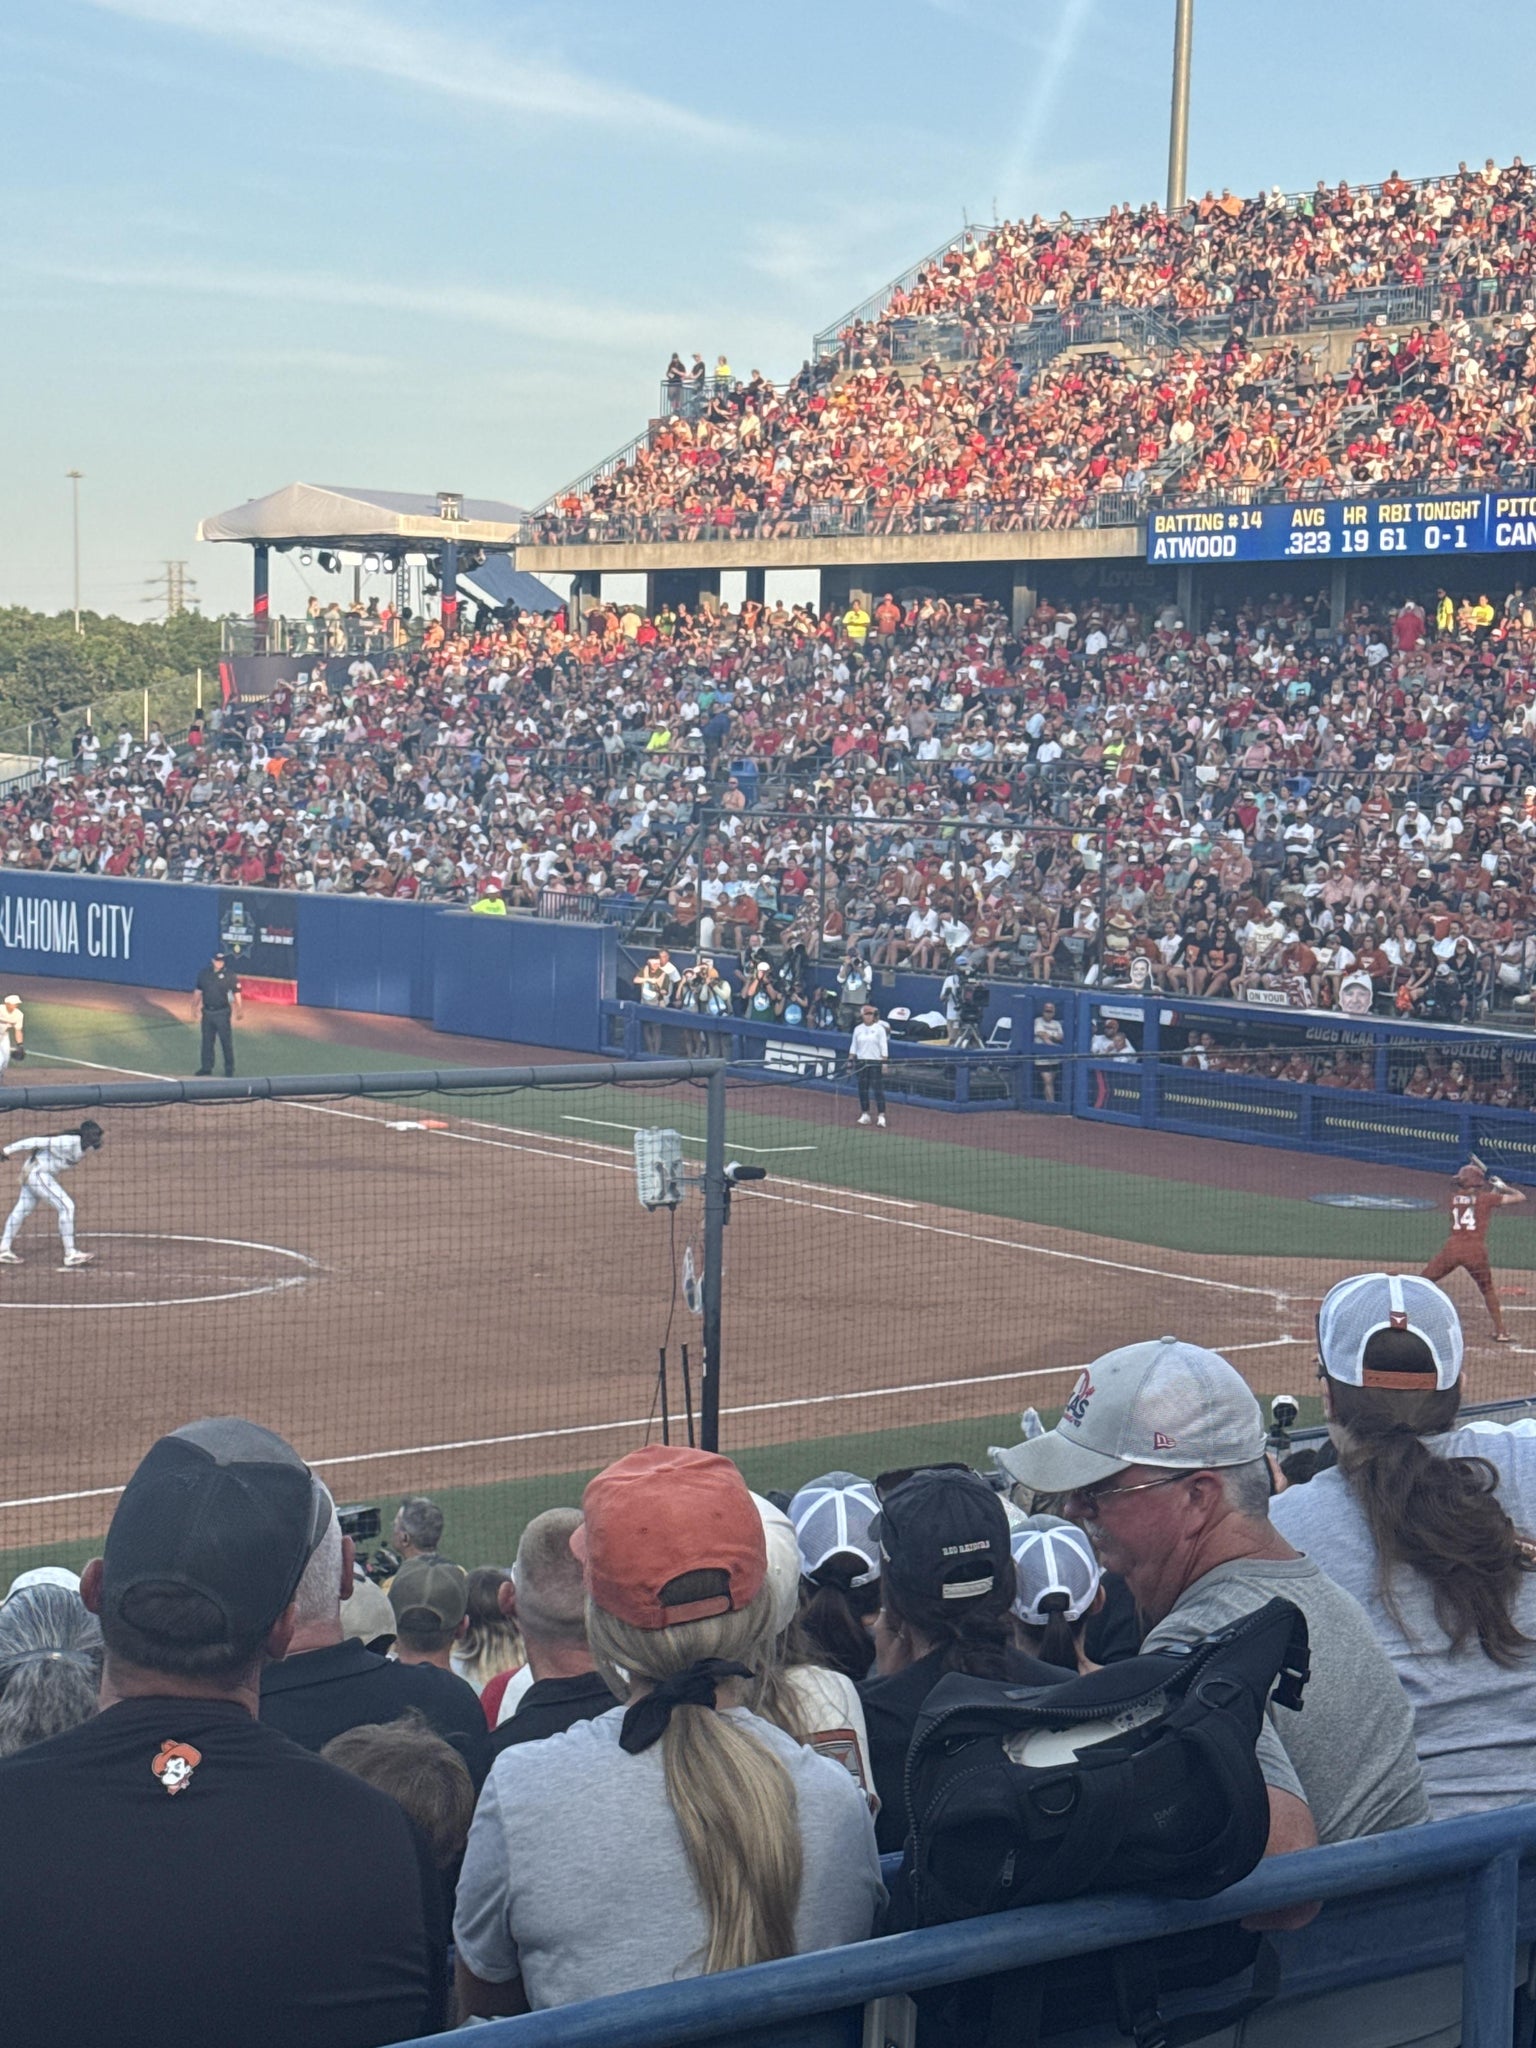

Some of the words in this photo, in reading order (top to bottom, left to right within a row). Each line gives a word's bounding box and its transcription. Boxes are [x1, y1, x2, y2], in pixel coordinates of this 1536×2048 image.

[1154, 512, 1224, 533] BATTING
[1228, 510, 1262, 530] #14
[1291, 507, 1325, 527] AVG
[1343, 505, 1368, 525] HR
[1378, 503, 1412, 523] RBI
[1415, 500, 1481, 521] TONIGHT
[1153, 534, 1237, 559] ATWOOD
[1284, 530, 1331, 554] .323
[1341, 529, 1369, 552] 19
[1379, 527, 1407, 551] 61
[1424, 524, 1467, 549] 0-1
[87, 902, 134, 960] CITY
[1248, 991, 1261, 1001] ON
[1263, 993, 1285, 1003] YOUR
[1341, 1030, 1374, 1047] NCAA
[763, 1040, 837, 1080] ESPN
[1452, 1207, 1476, 1231] 14
